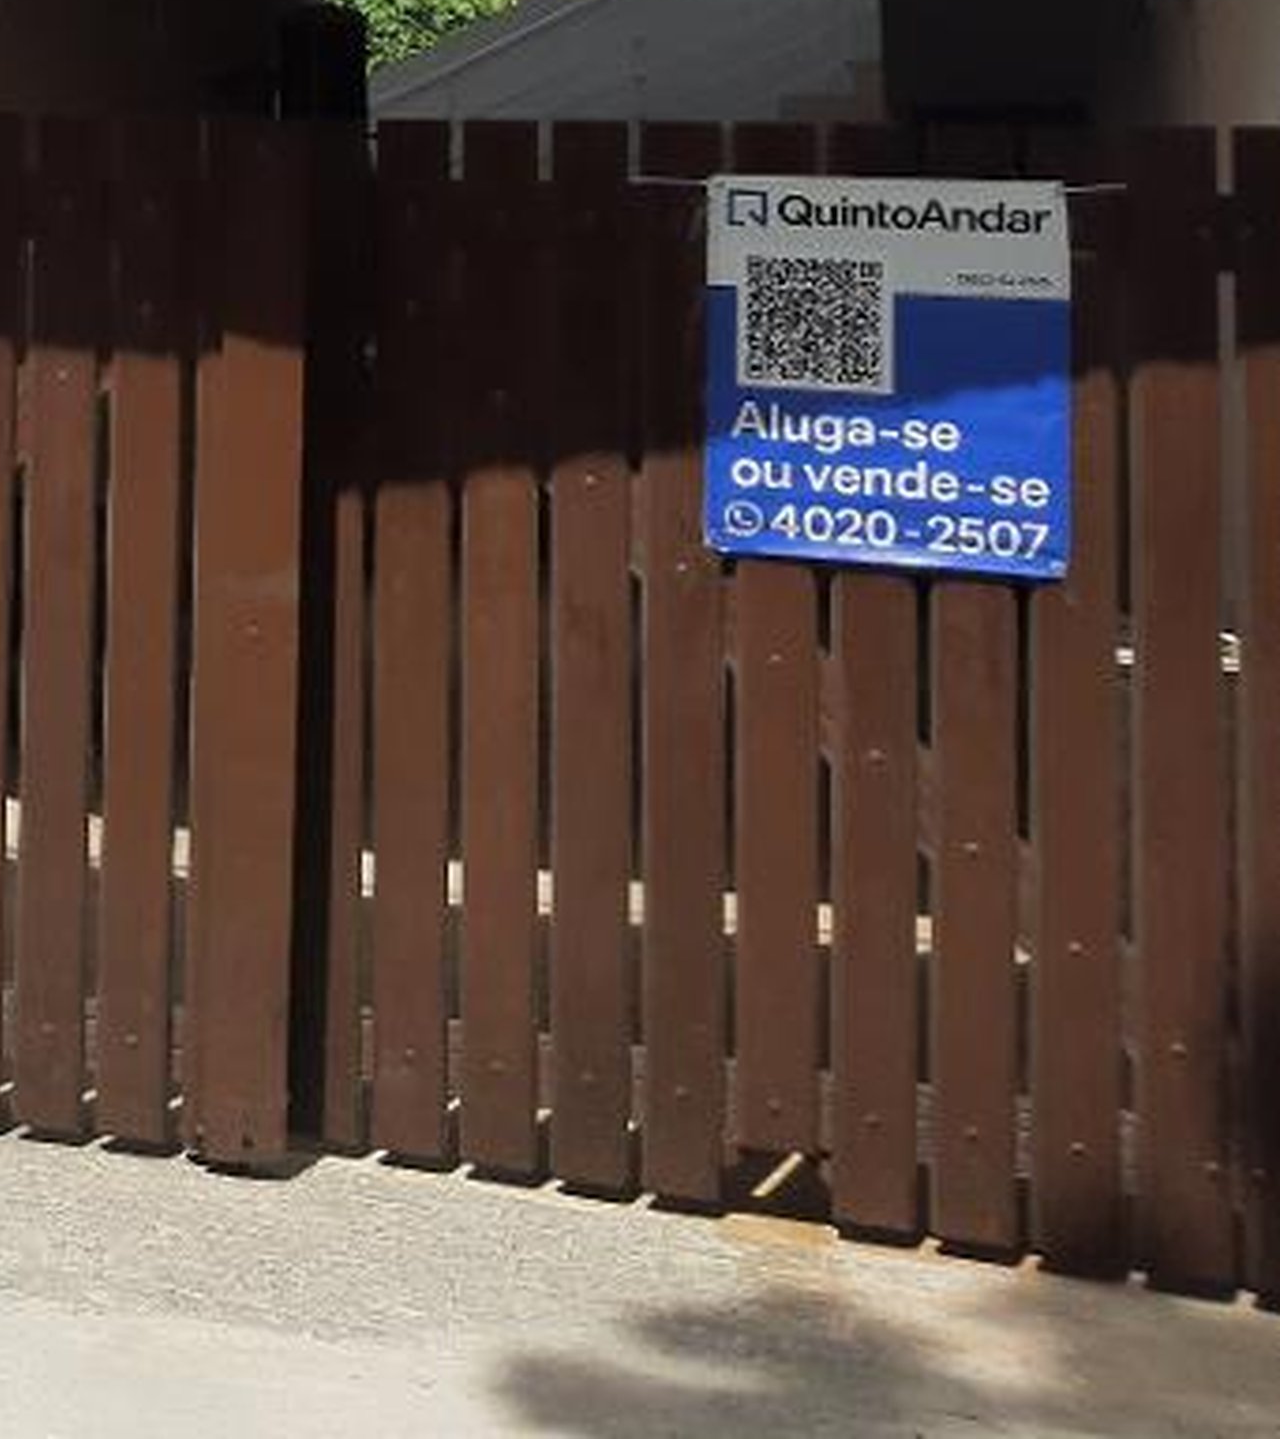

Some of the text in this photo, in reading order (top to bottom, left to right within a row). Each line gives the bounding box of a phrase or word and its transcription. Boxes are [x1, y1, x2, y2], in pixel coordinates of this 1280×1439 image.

[777, 193, 1052, 236] QuintoAndar
[731, 401, 962, 454] Aluga-se
[730, 458, 1051, 507] ou vende-se
[770, 505, 1050, 559] 4020-2507
